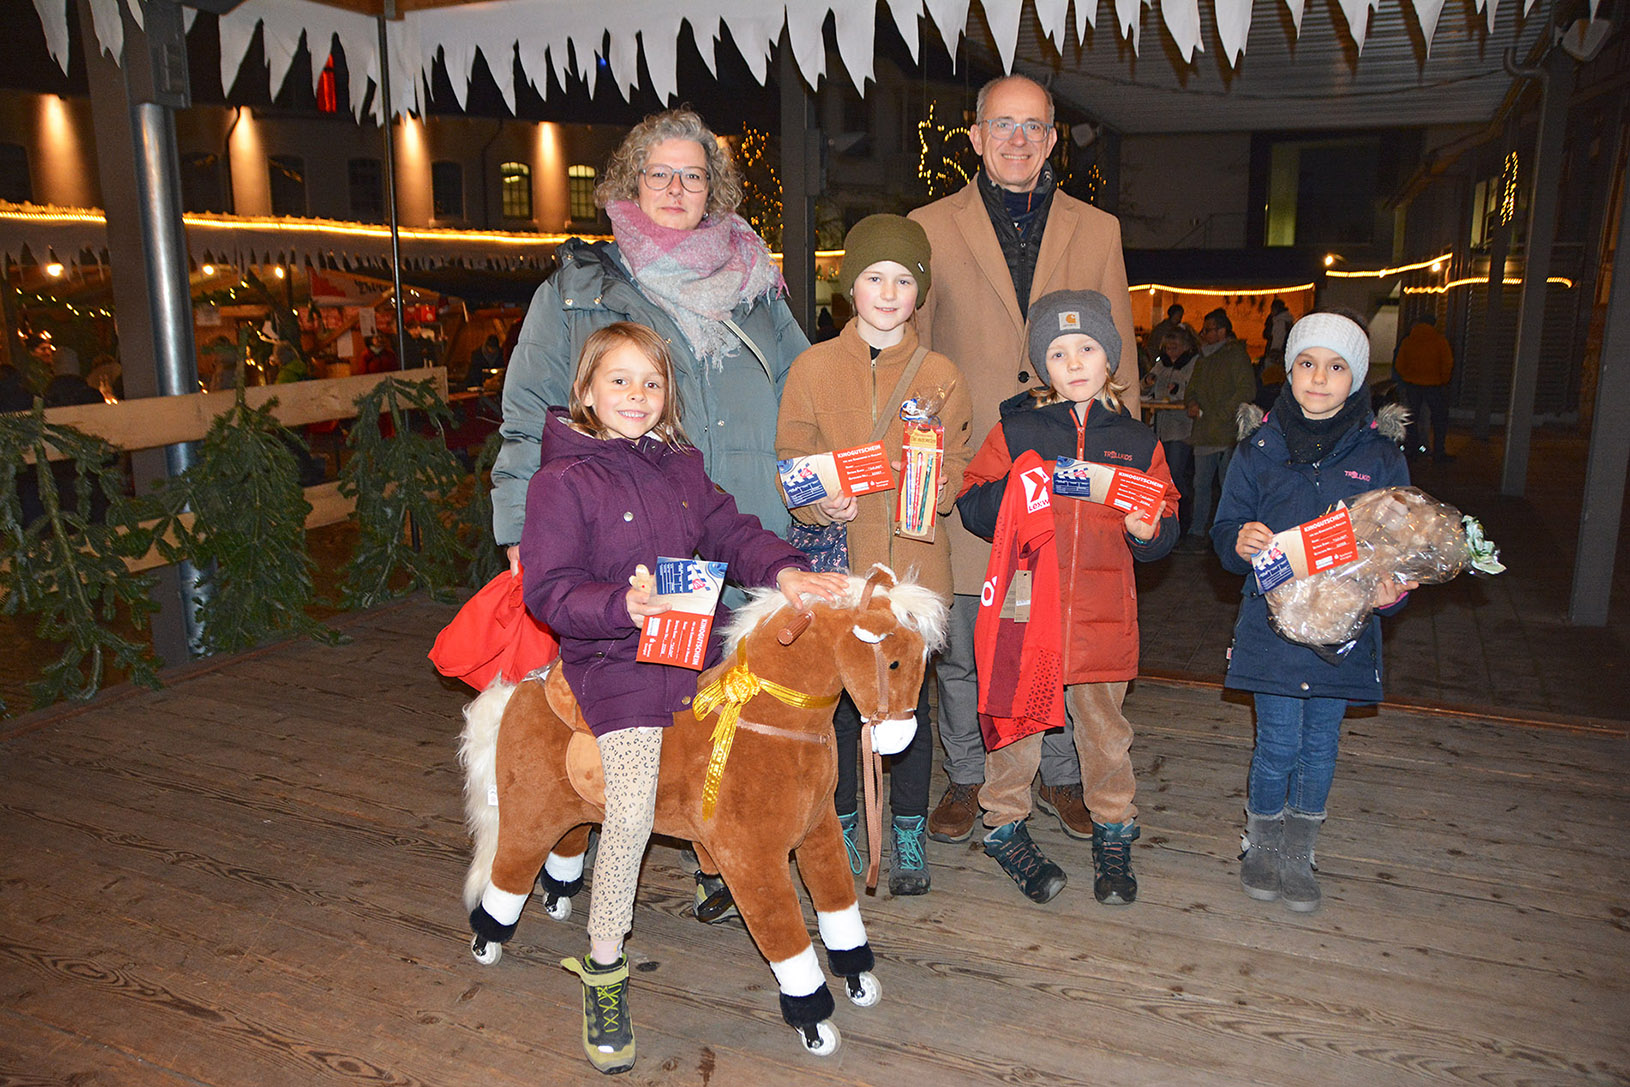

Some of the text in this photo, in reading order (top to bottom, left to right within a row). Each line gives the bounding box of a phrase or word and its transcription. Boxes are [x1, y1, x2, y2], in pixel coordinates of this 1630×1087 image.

[837, 444, 882, 458] KINOGUTSCHEIN
[1118, 472, 1164, 488] KINOGUTSCHEIN
[1304, 512, 1346, 532] KINOGUTSCHEIN
[692, 618, 708, 665] KINOGUTSCHEIN
